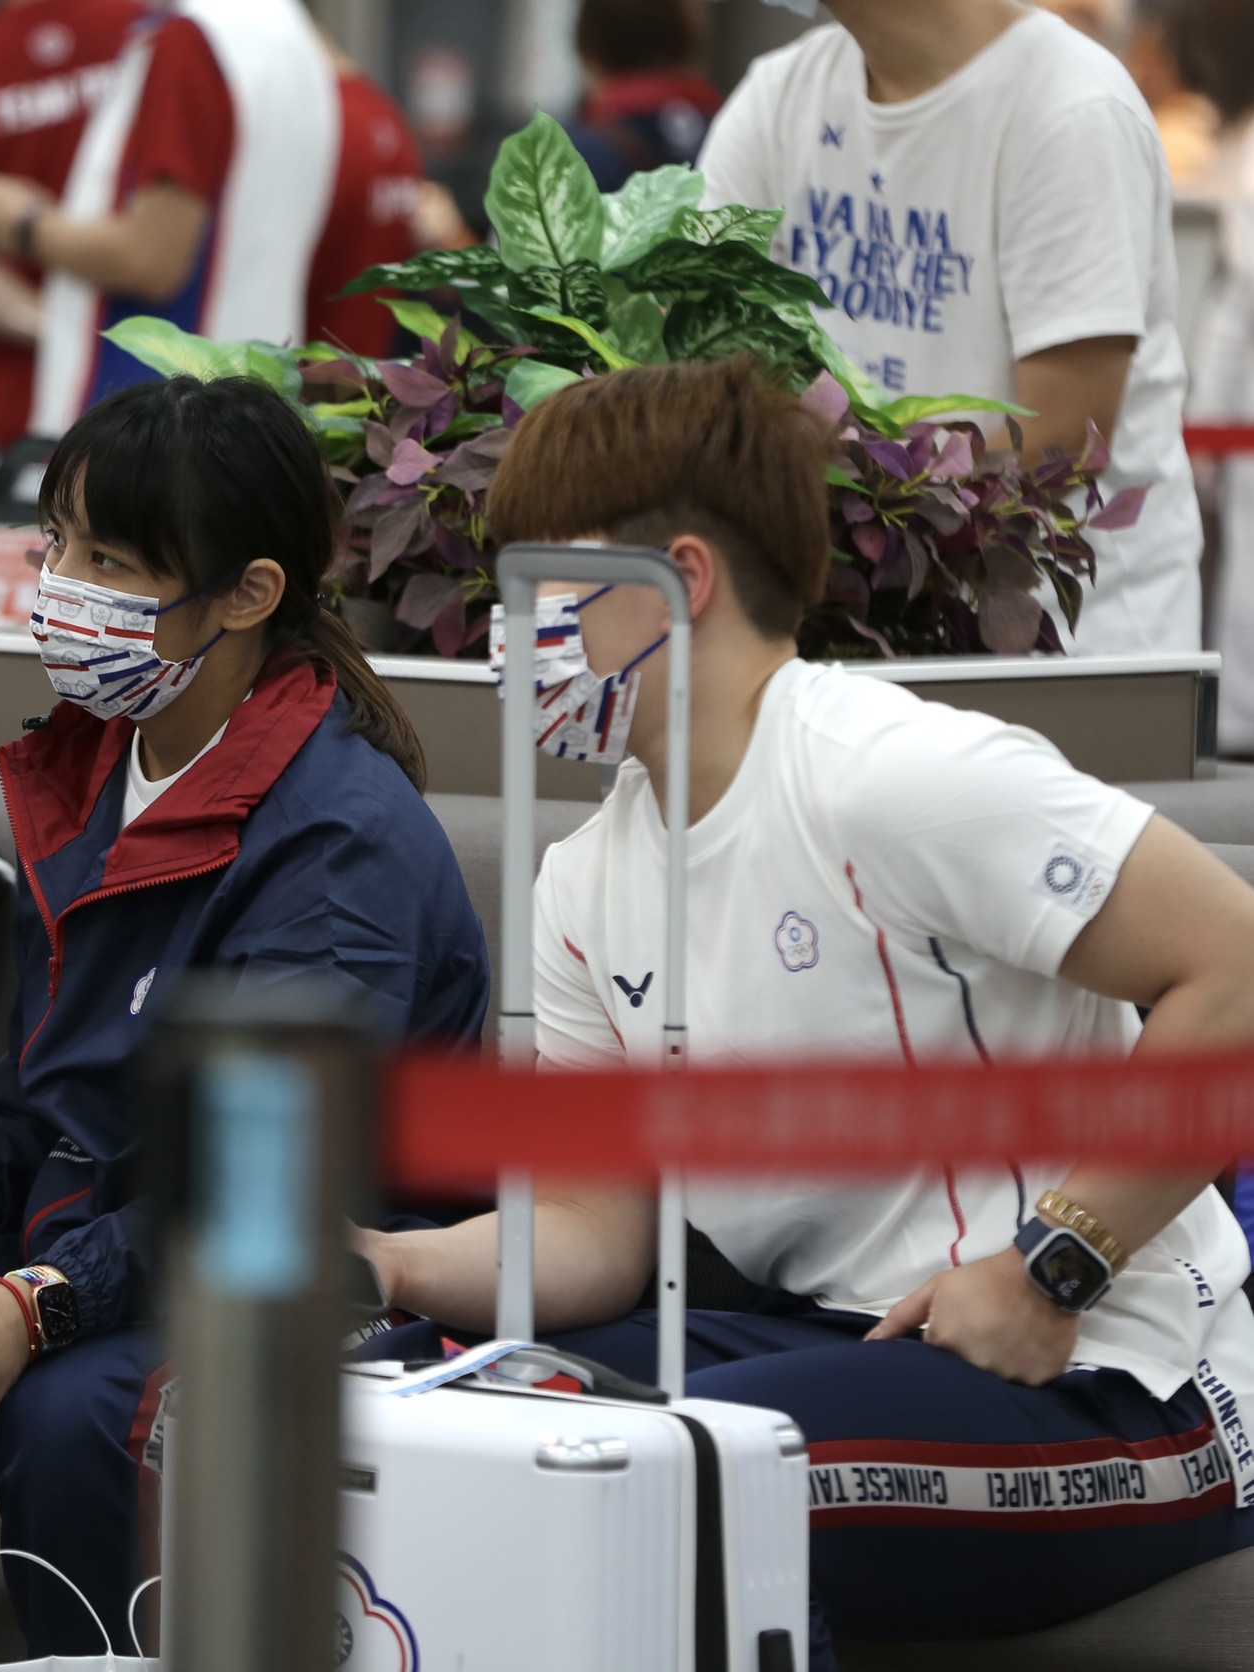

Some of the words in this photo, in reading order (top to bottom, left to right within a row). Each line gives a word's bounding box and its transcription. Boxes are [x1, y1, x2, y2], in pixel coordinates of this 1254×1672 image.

[906, 209, 952, 256] NA
[912, 250, 974, 295] HEY
[1197, 1358, 1254, 1473] CHINESE
[852, 1467, 948, 1505] CHINESE
[986, 1470, 1055, 1508] TAIPEI
[1059, 1462, 1147, 1505] CHINESE
